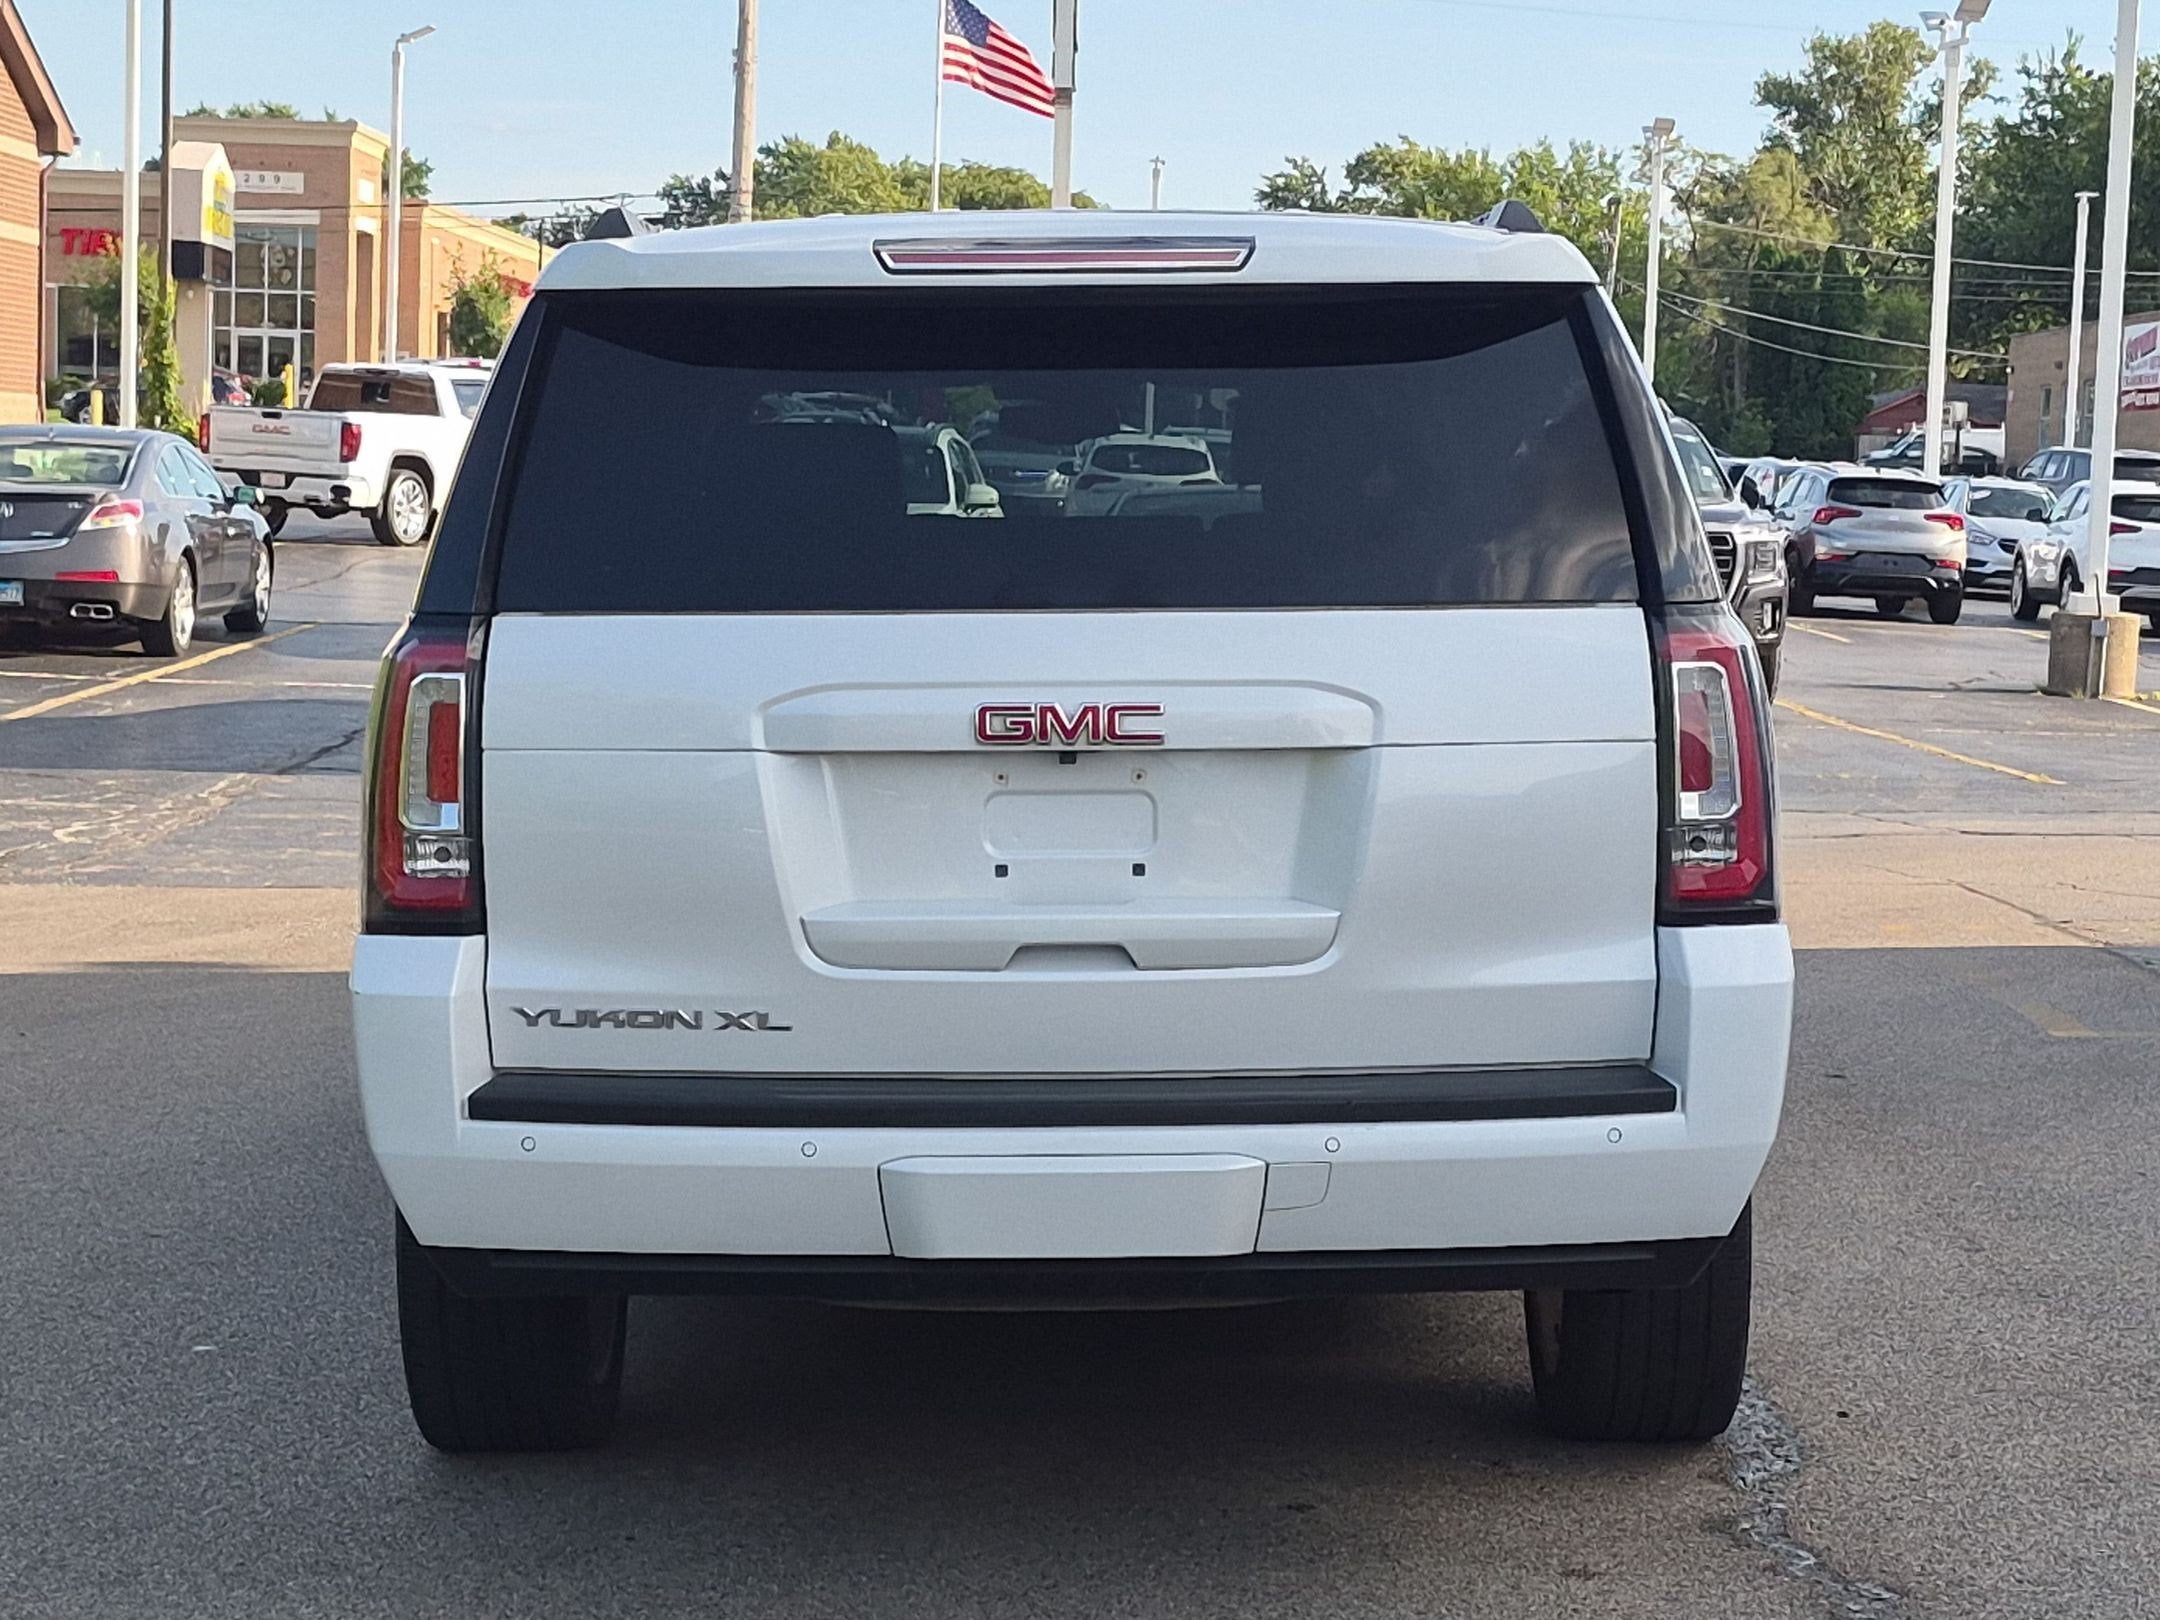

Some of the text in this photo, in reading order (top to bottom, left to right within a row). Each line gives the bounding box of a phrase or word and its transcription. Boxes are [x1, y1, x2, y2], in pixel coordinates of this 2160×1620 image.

[252, 423, 291, 435] GMC
[975, 703, 1165, 745] GMC
[510, 1006, 793, 1032] YUKON XL
